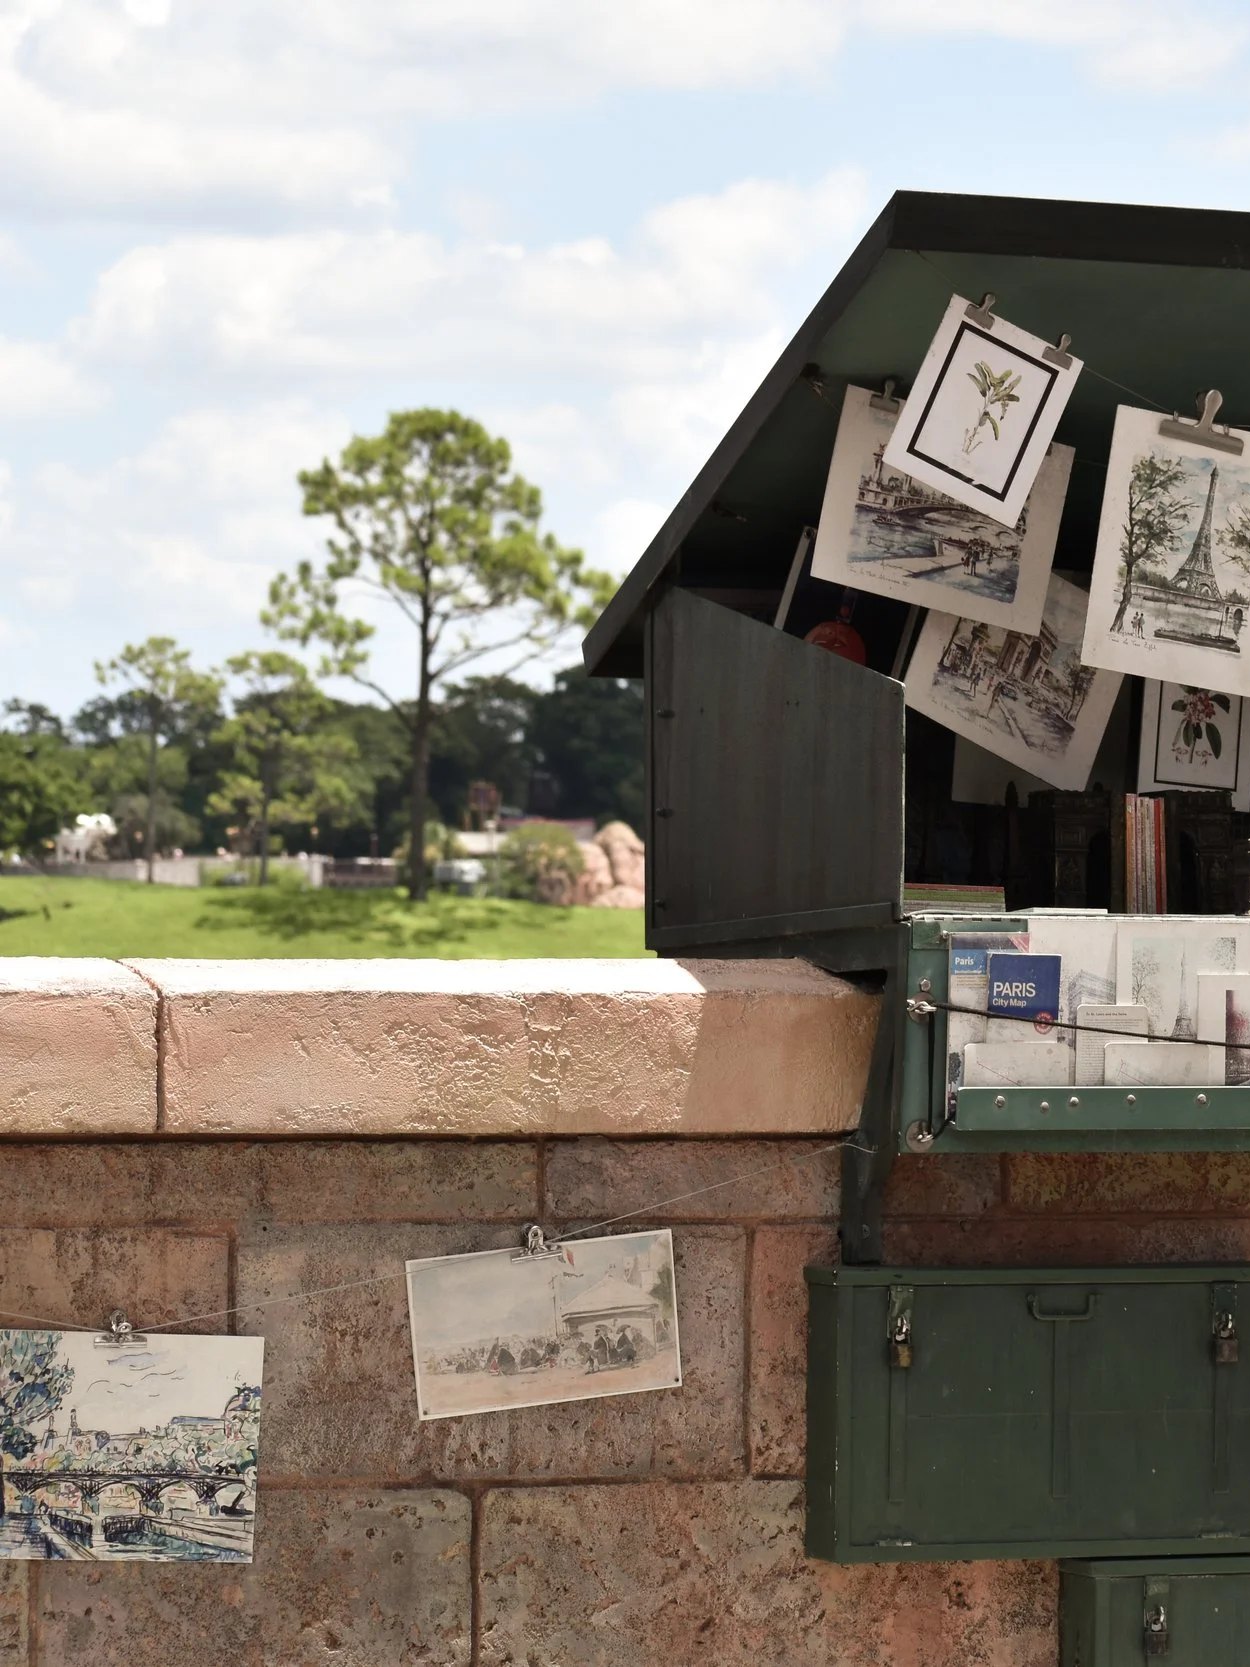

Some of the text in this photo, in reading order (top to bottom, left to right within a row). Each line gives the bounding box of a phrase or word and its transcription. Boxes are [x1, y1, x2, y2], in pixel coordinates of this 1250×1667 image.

[955, 957, 974, 966] Paris
[993, 982, 1036, 998] PARIS
[992, 998, 1027, 1008] City Map
